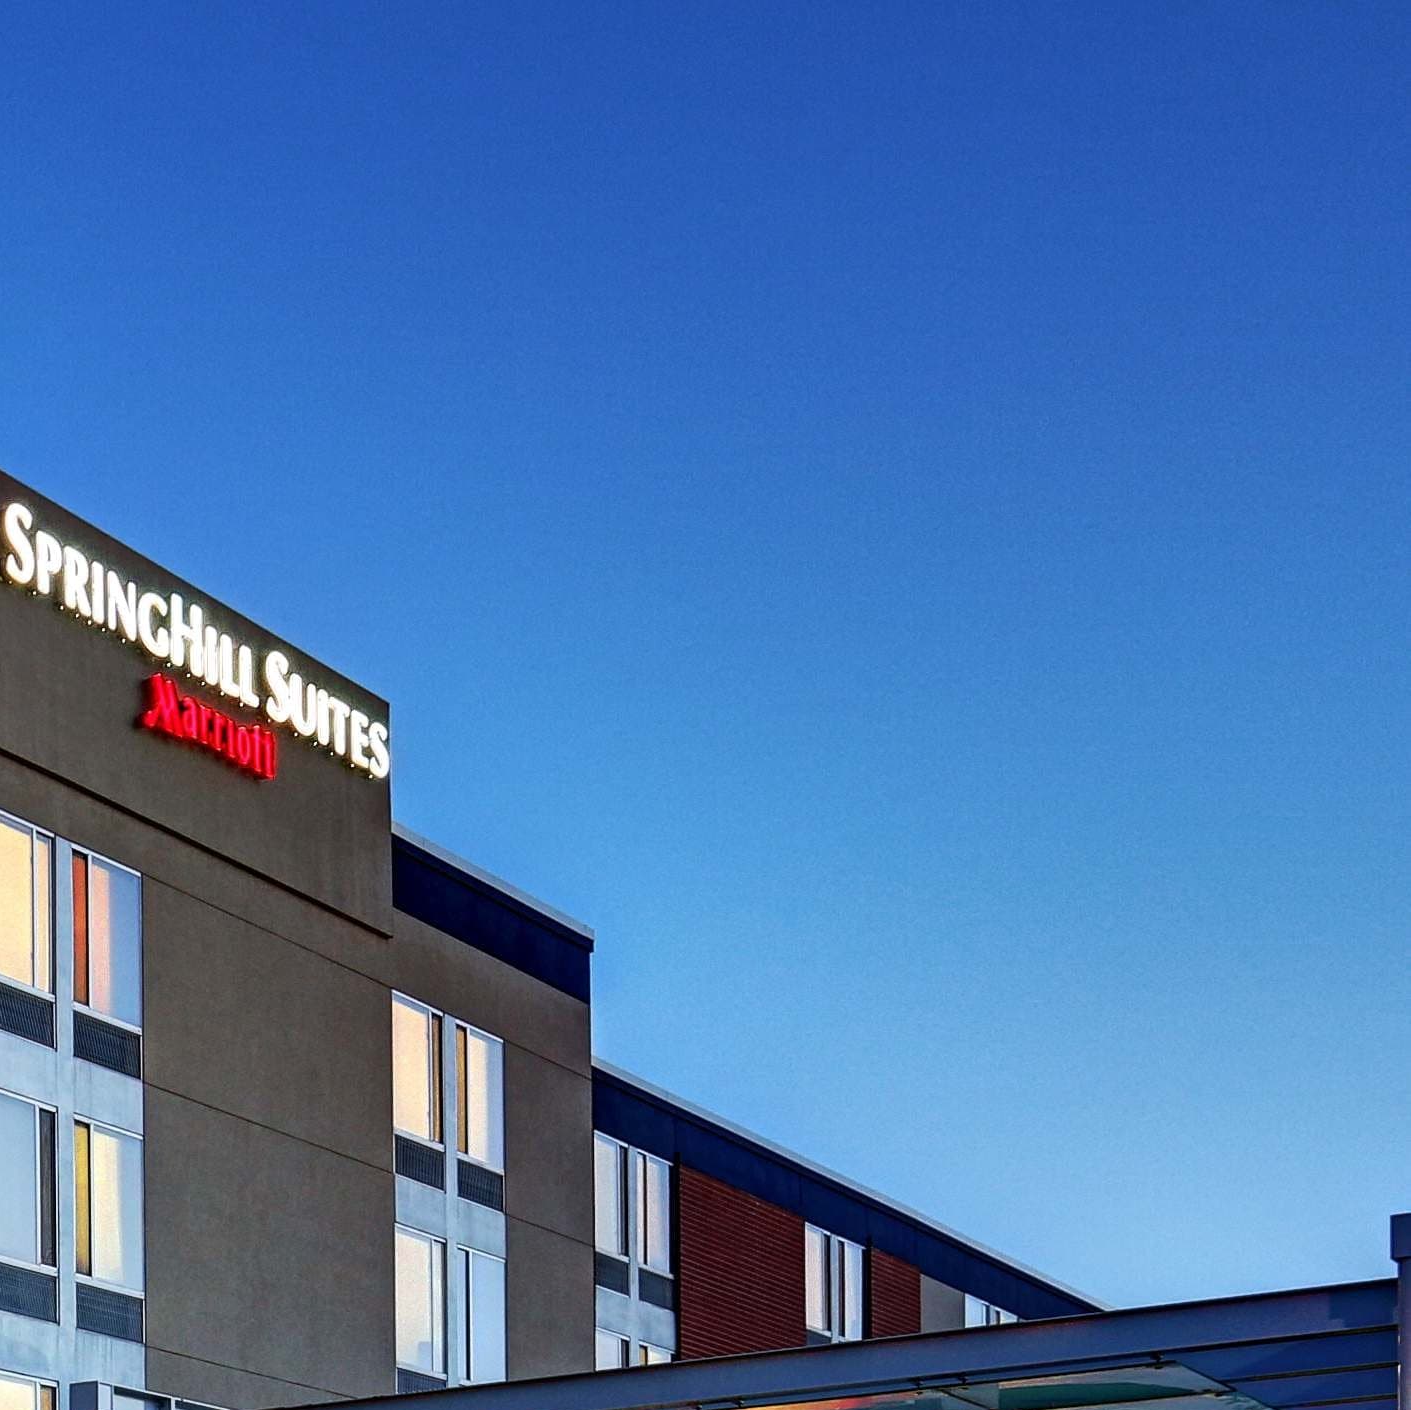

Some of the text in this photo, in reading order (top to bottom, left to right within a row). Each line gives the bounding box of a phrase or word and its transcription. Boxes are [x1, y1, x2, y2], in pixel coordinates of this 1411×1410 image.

[4, 502, 390, 779] SPRINGHILL SUITES
[141, 672, 277, 781] Marriott
